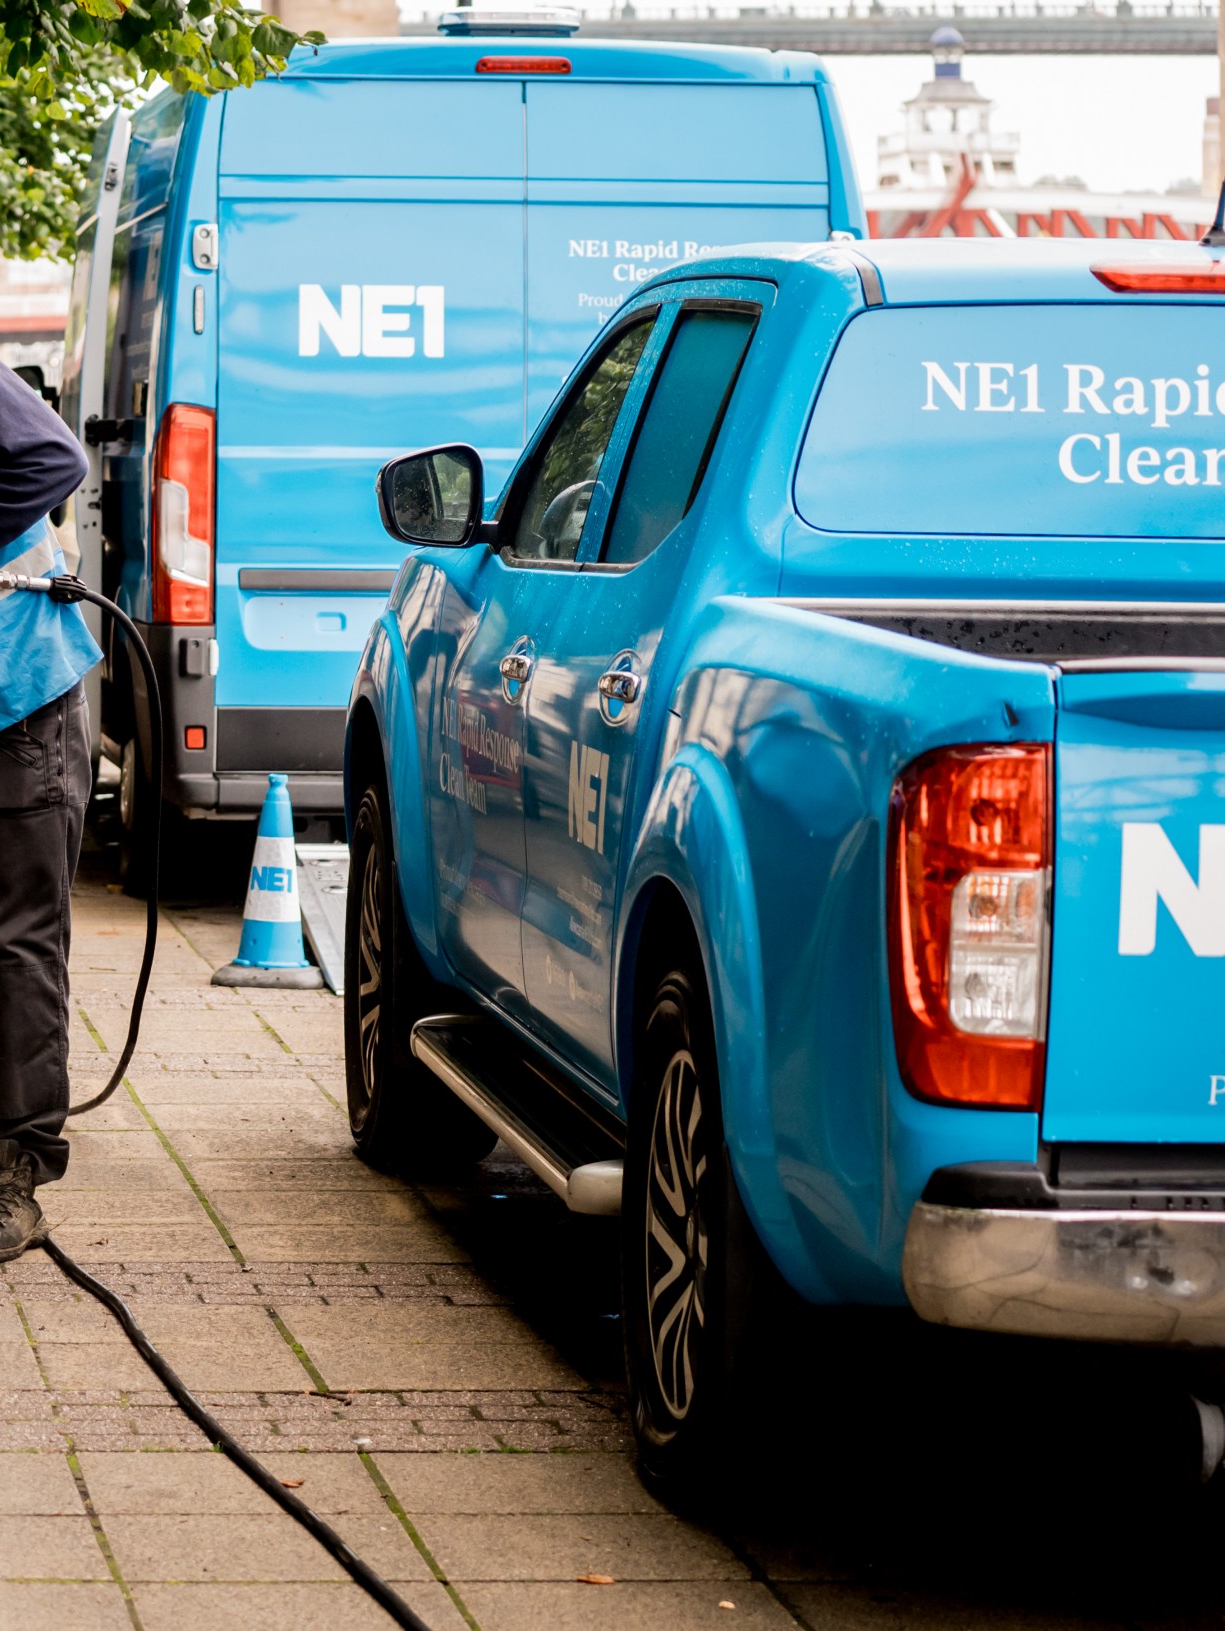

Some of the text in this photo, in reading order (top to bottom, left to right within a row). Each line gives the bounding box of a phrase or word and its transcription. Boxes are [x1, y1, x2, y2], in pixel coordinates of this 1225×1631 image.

[569, 240, 609, 258] NE1
[615, 240, 678, 262] Rapid
[299, 284, 445, 358] NE1
[921, 361, 1045, 413] NE1
[458, 703, 479, 758] Rapid
[479, 714, 520, 774] Response
[439, 752, 487, 816] Clean Team
[568, 740, 610, 855] NE1
[250, 866, 293, 893] NE1
